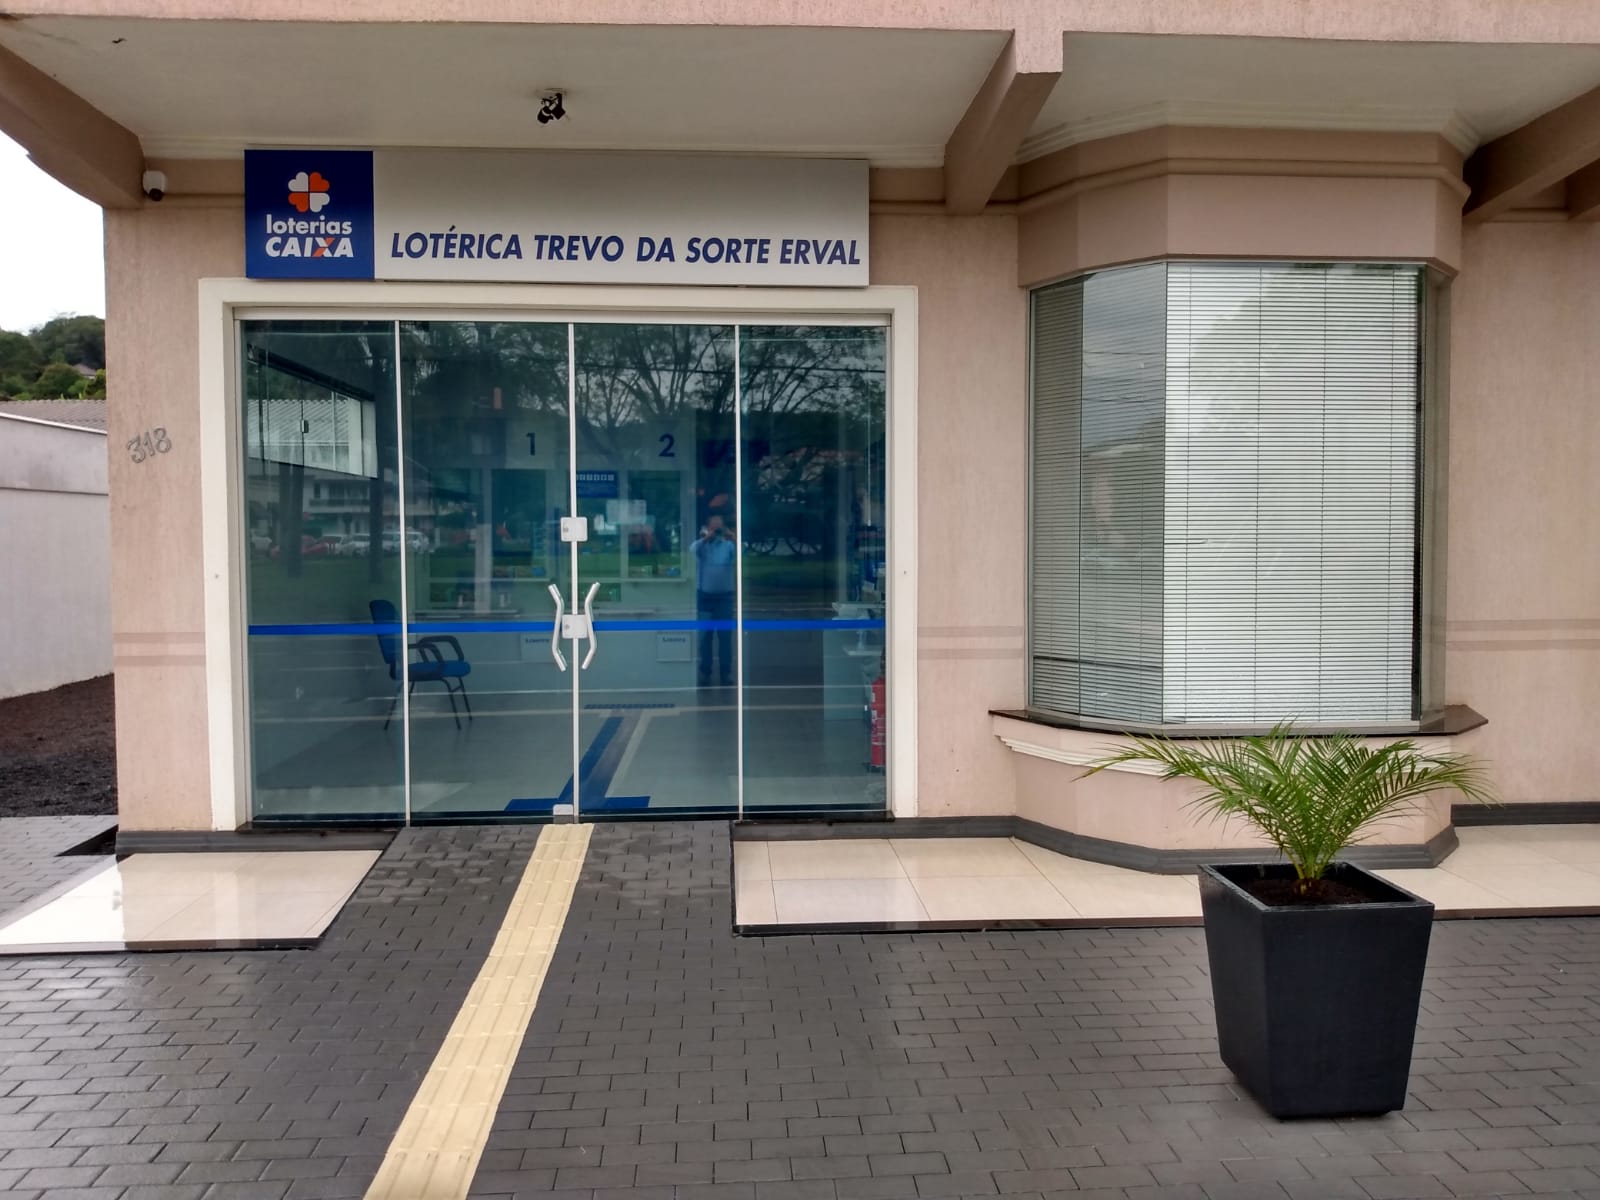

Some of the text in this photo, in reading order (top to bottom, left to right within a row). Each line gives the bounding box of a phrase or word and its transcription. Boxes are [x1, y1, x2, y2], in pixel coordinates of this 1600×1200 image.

[265, 214, 352, 235] loterias
[265, 236, 354, 258] CAIXA
[391, 224, 861, 265] LOTÉRICA TREVO DA SORTE ERVAL
[127, 427, 172, 464] 318
[525, 432, 536, 456] 1
[658, 433, 676, 458] 2
